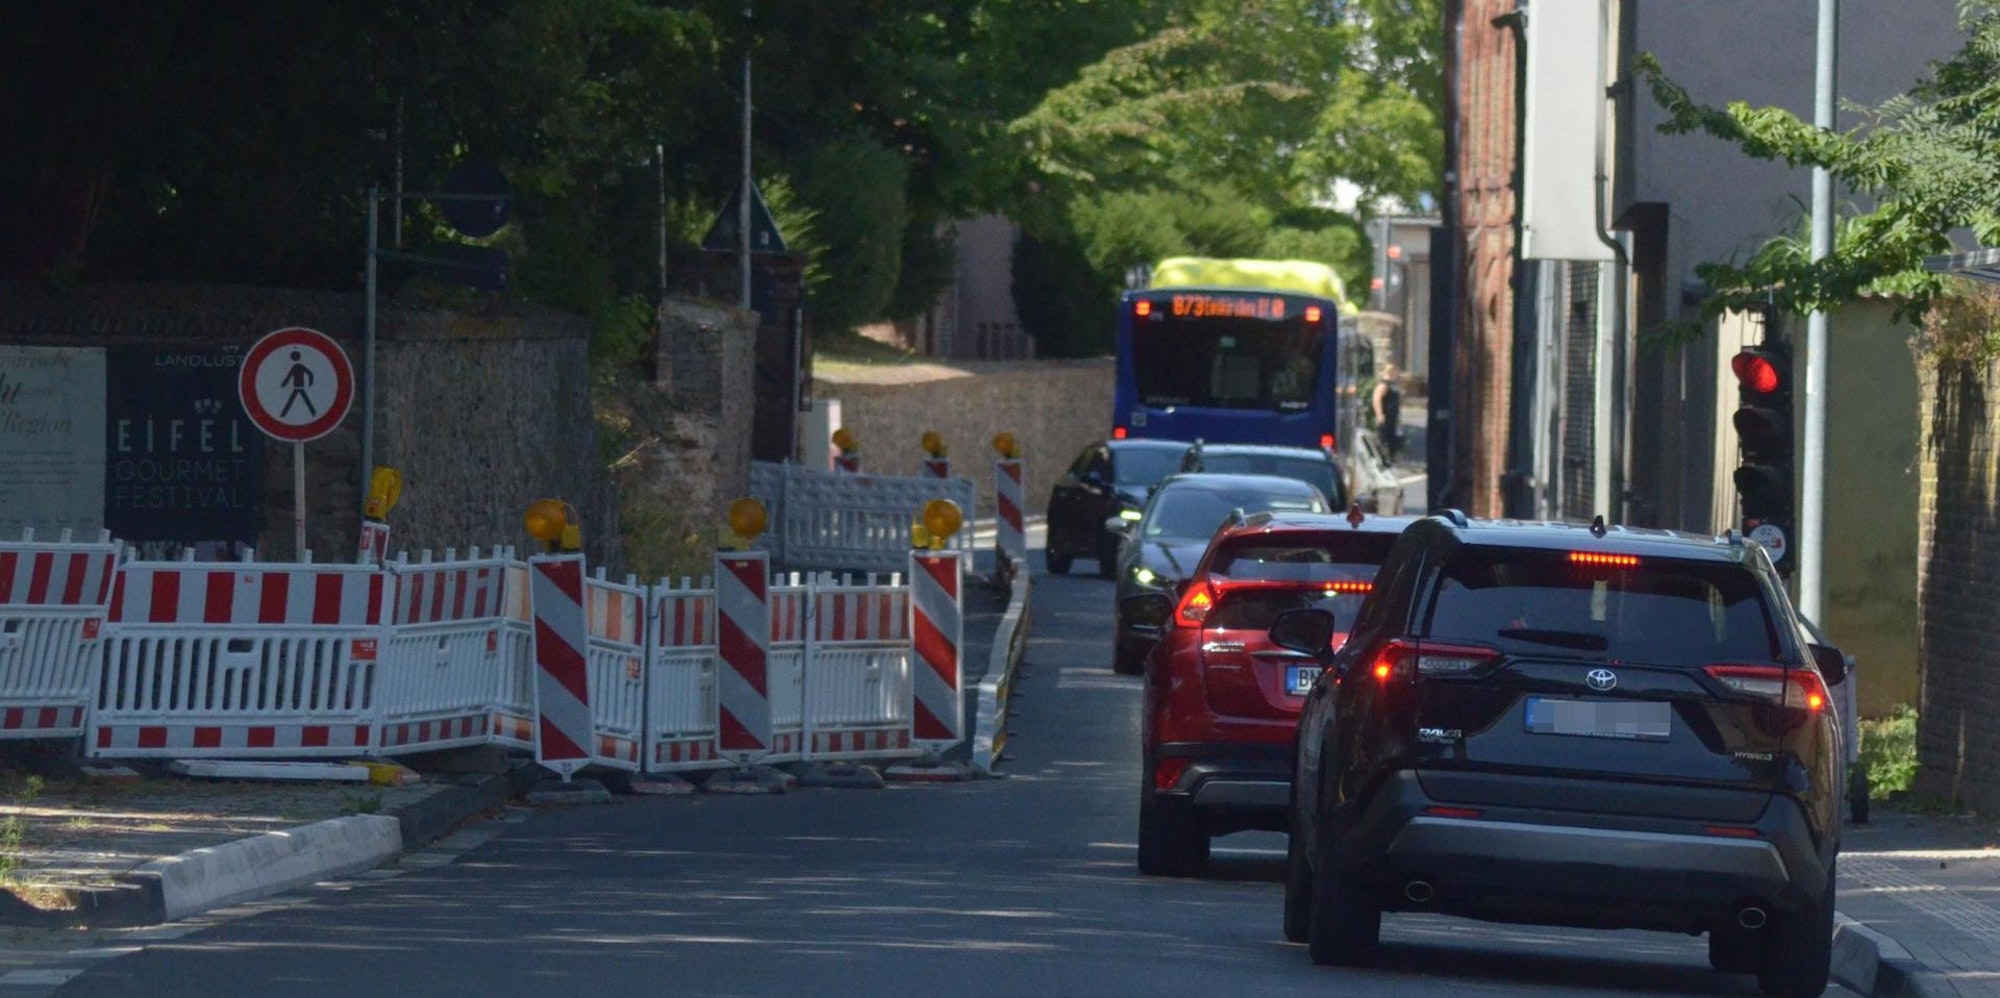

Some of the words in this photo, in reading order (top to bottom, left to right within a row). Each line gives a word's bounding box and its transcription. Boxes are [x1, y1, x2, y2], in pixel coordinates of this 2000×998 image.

[155, 354, 245, 368] LANDLUST
[117, 417, 244, 452] EIFEL
[116, 459, 245, 482] GOURMET
[116, 486, 244, 509] FESTIVAL
